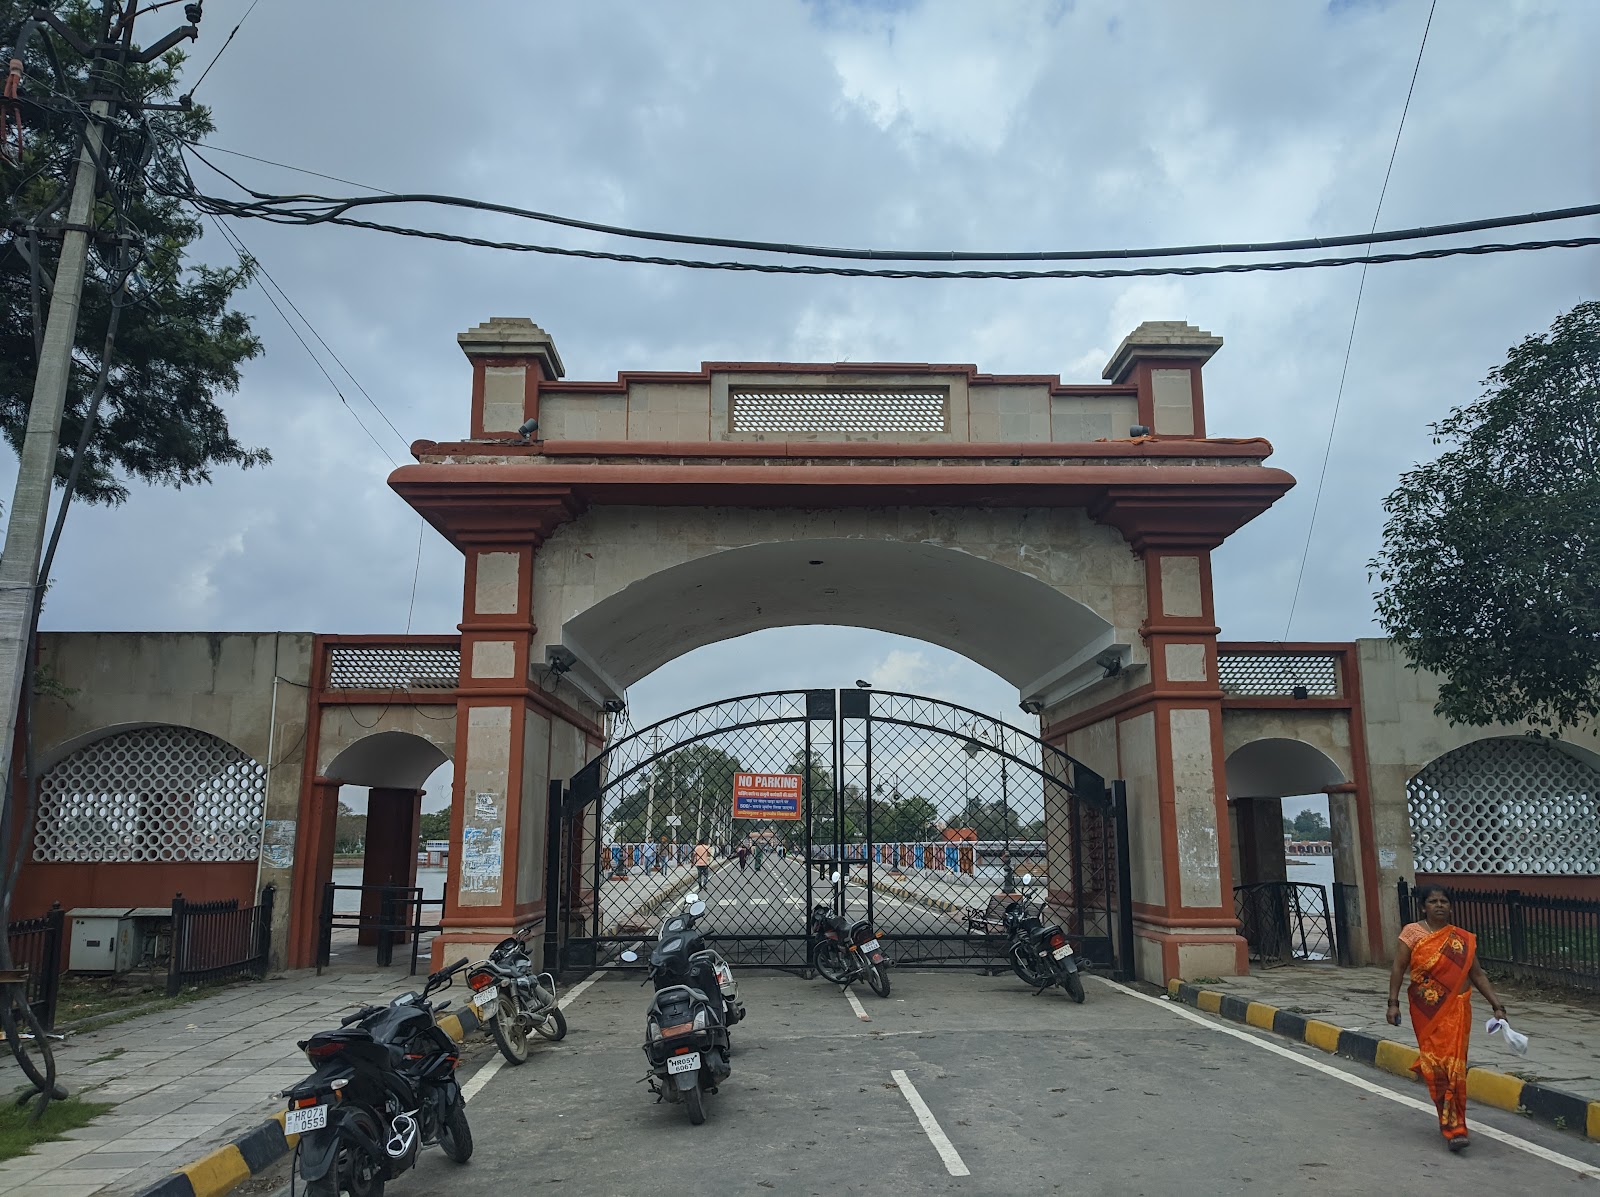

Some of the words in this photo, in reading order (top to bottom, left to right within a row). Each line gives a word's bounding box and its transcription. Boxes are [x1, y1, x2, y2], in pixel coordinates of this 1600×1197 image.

[739, 776, 752, 787] NO
[755, 776, 797, 788] PARKING
[671, 1056, 695, 1067] HR05Y
[675, 1063, 693, 1071] 6067
[295, 1107, 324, 1121] HR07A
[301, 1116, 325, 1130] 0559
